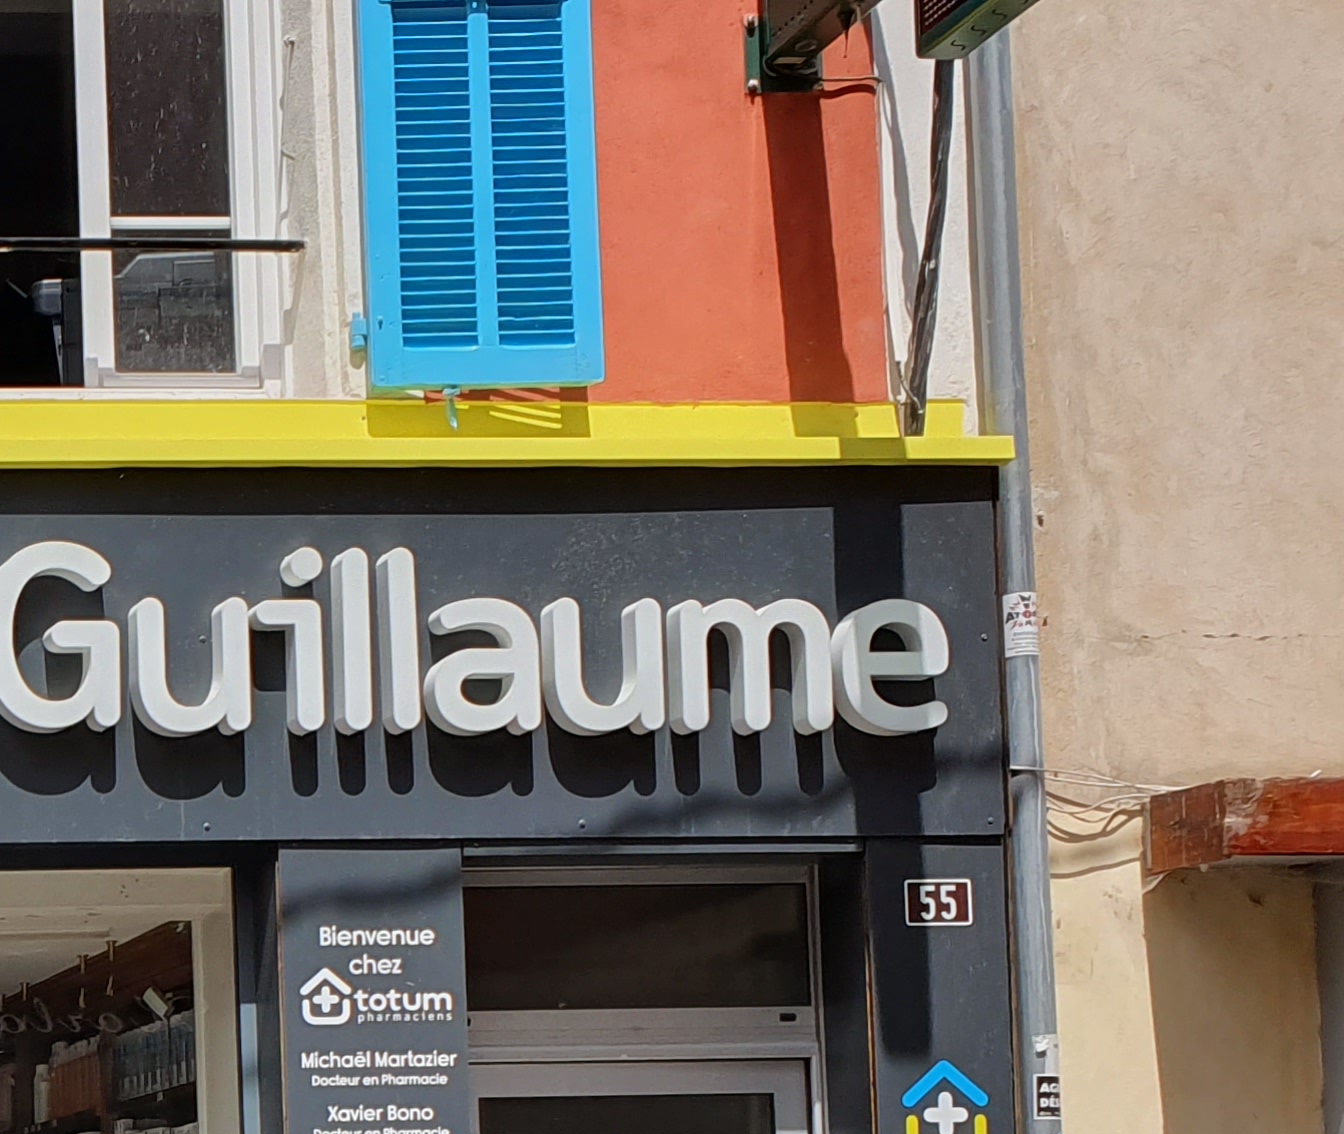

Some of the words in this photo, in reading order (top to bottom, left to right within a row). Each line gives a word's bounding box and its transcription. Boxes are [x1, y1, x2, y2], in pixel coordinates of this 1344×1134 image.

[919, 884, 958, 921] 55
[319, 925, 435, 947] Bienvenue
[349, 953, 402, 975] chez
[353, 988, 452, 1012] totum
[357, 1012, 453, 1025] pharmaciens
[301, 1050, 370, 1069] Michaël
[375, 1050, 457, 1068] Martazier
[312, 1074, 360, 1087] Docteur
[362, 1076, 379, 1086] en
[381, 1073, 448, 1086] Pharmacie
[327, 1105, 384, 1122] Xavier
[387, 1105, 434, 1122] Bono
